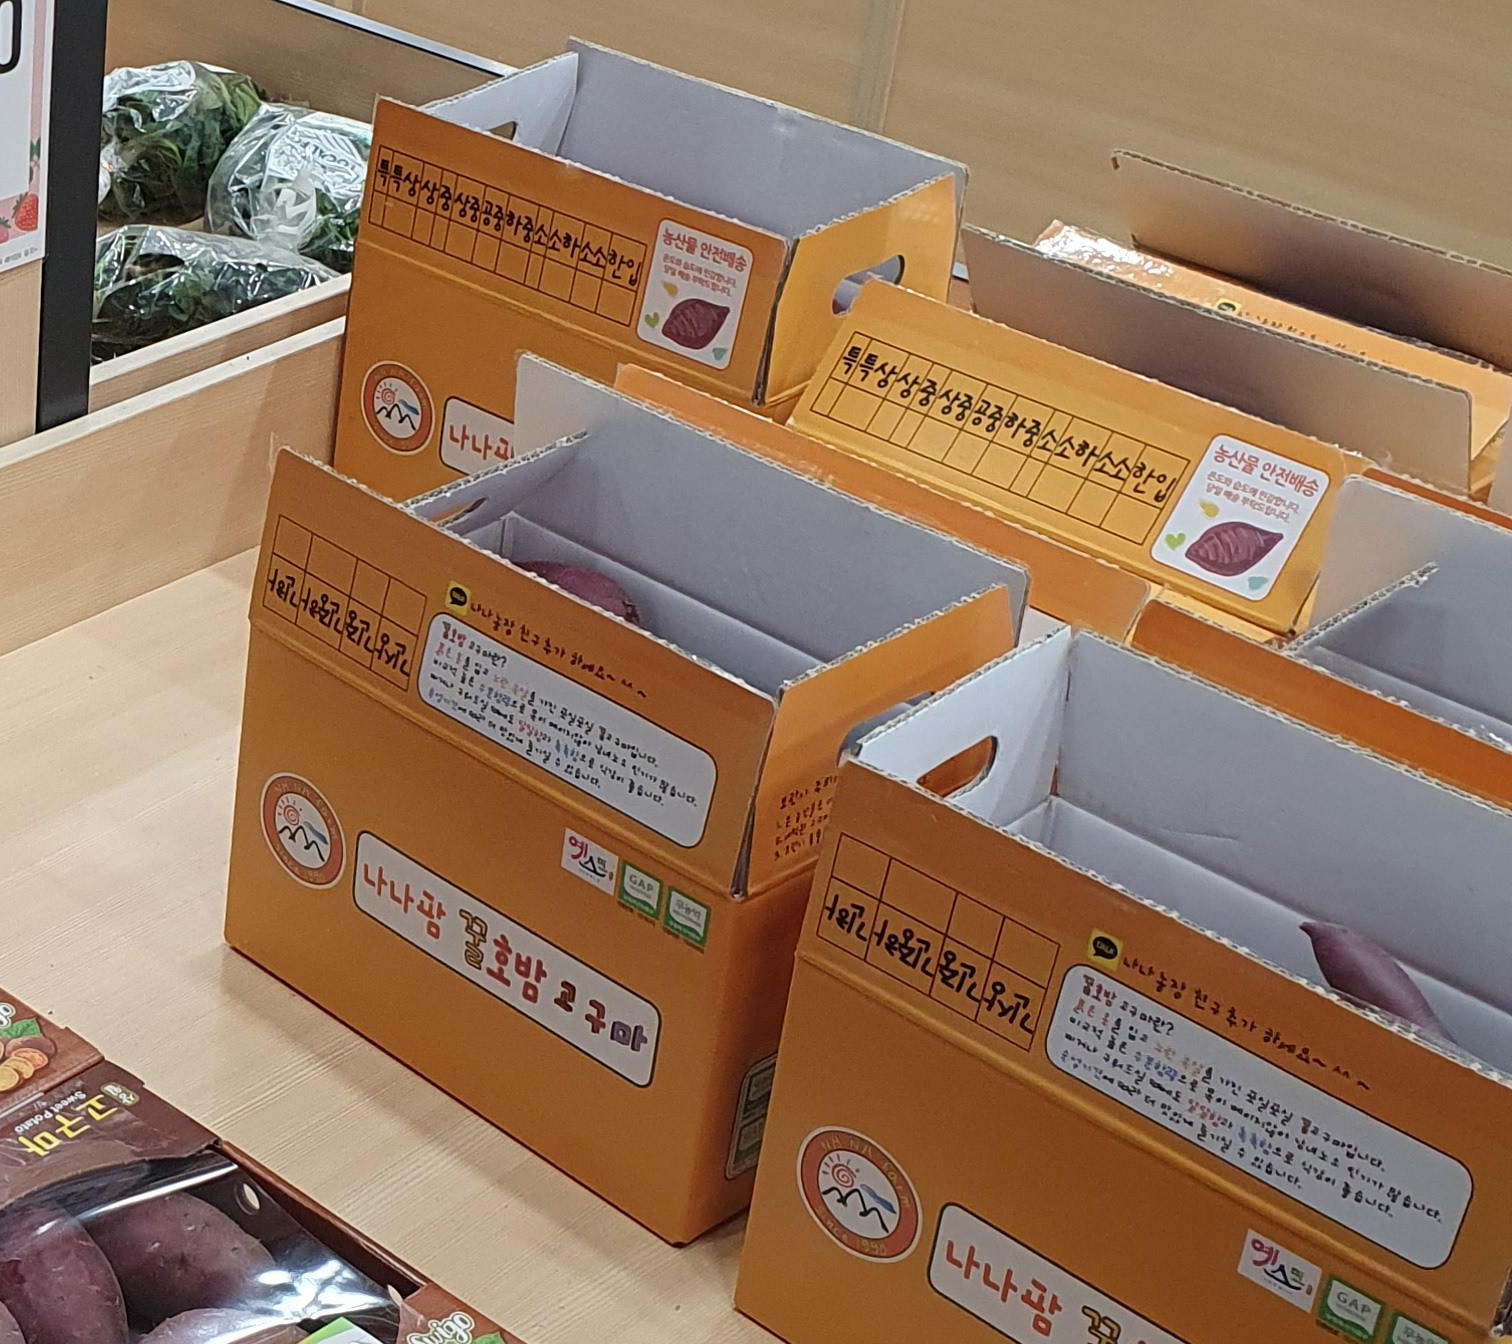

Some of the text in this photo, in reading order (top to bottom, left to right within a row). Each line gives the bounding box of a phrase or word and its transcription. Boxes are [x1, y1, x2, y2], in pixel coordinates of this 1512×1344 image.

[663, 228, 747, 272] 농산물 안전배송
[1214, 444, 1320, 497] 농산물 안전배송
[628, 873, 655, 892] GAP
[363, 863, 648, 1052] 나나팜 꿀호밤 고구마
[825, 894, 1035, 1035] 긴하 긴중하 긴중 긴상
[1123, 956, 1187, 1000] 나나농장
[17, 1094, 121, 1157] 고구마
[946, 1239, 1063, 1337] 나나팜
[1336, 1291, 1373, 1316] GAP
